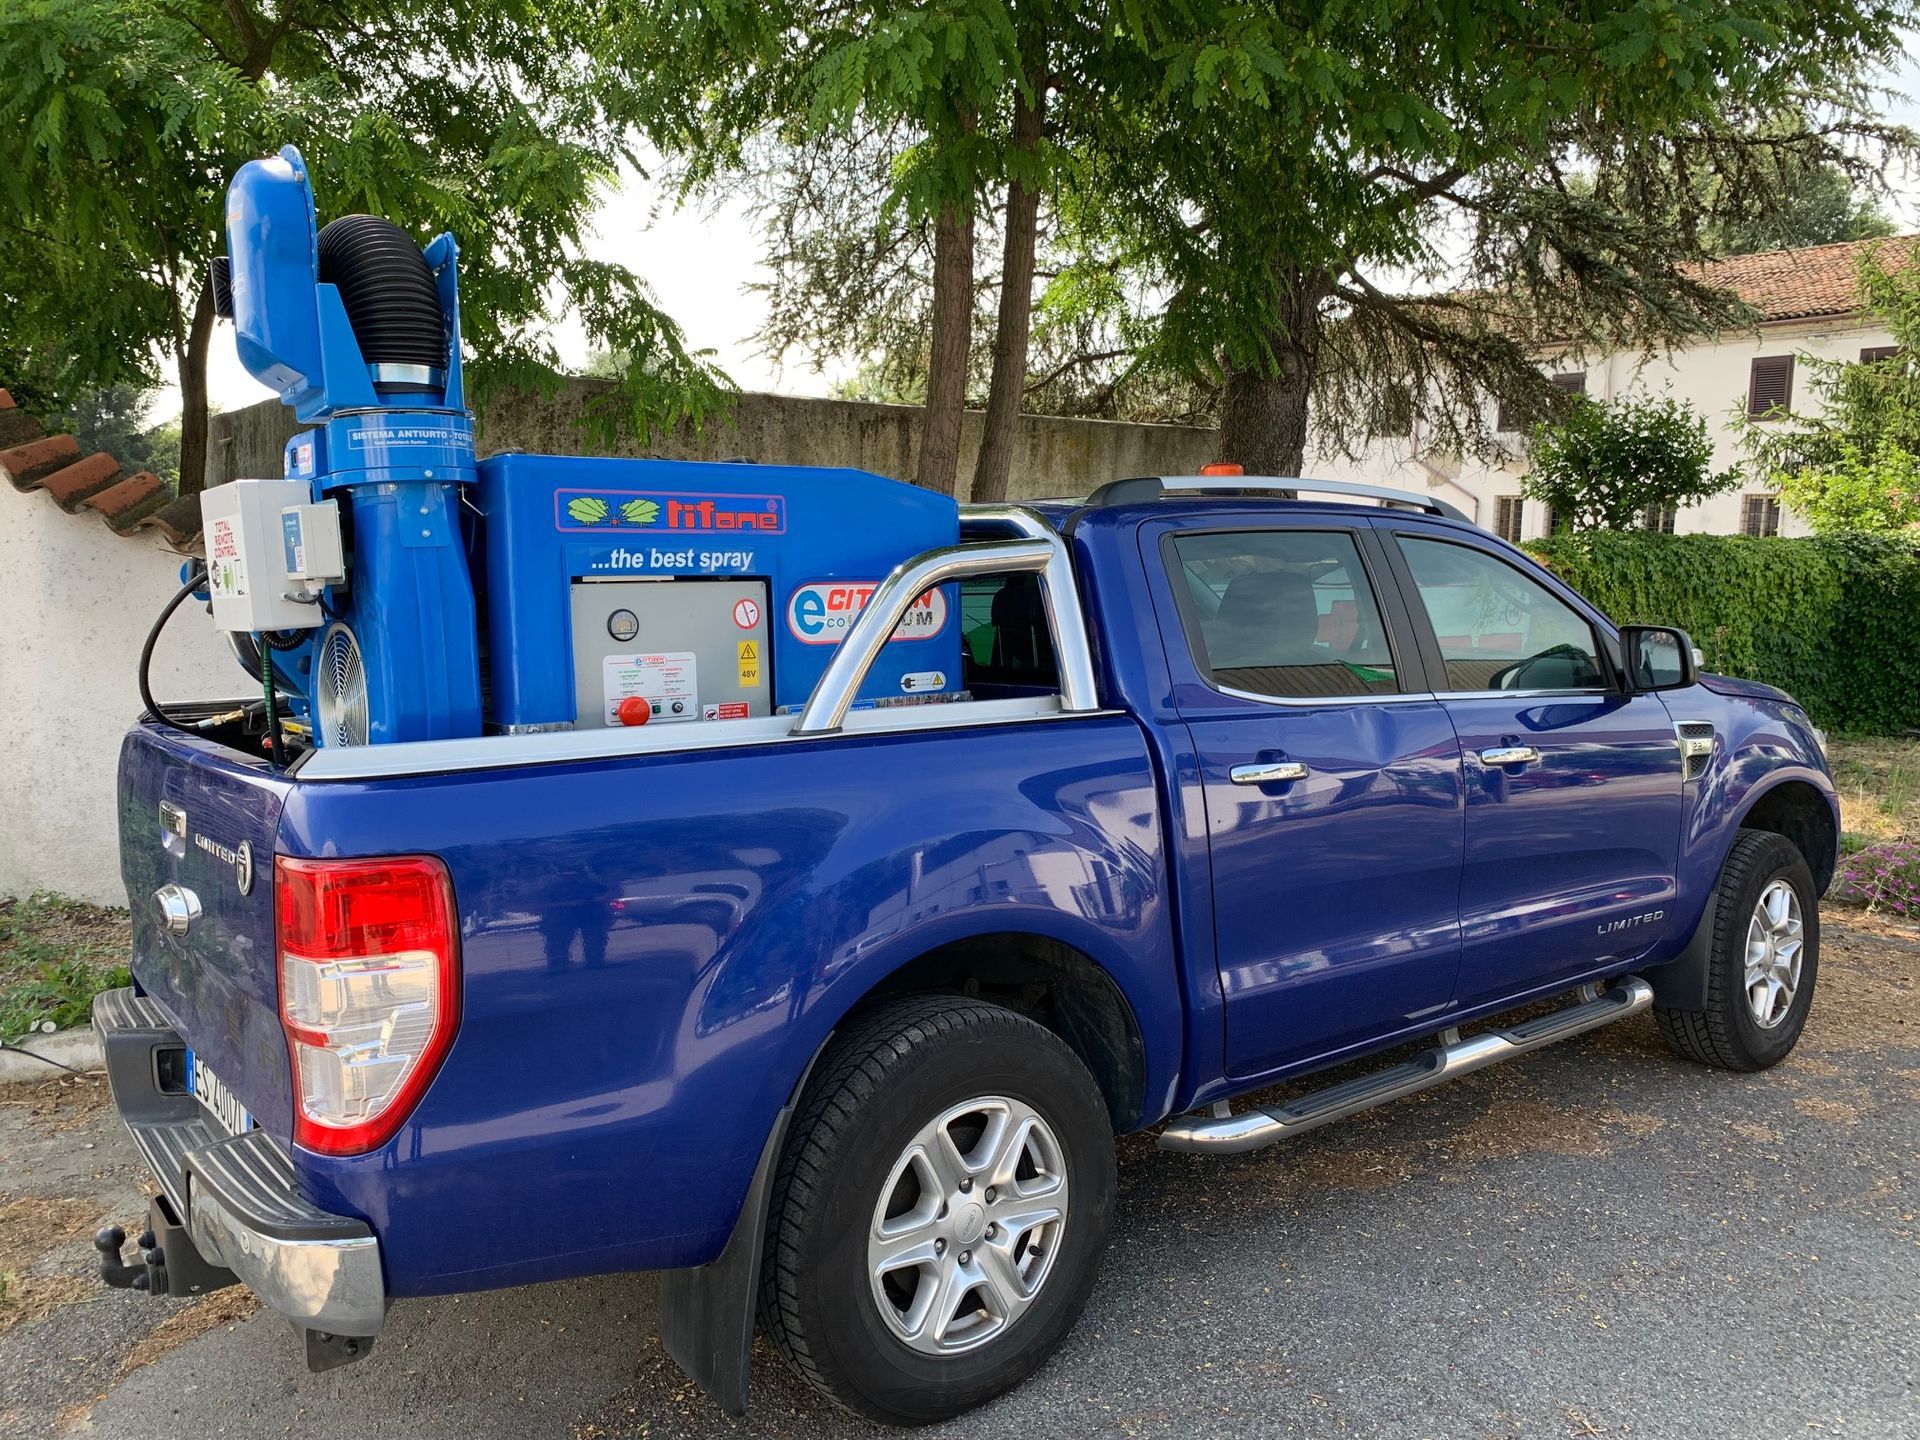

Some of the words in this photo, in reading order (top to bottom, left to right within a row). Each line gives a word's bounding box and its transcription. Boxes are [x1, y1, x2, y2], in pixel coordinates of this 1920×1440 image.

[352, 431, 395, 441] SISTEMA
[397, 430, 448, 439] ANTIURTO
[667, 499, 778, 530] tifone
[215, 520, 230, 533] TOTAL
[215, 532, 234, 546] REMOTE
[215, 545, 237, 559] CONTROL
[650, 548, 695, 568] best
[699, 551, 753, 572] spray
[741, 670, 756, 678] 48V
[195, 833, 236, 865] LIMITED
[1596, 910, 1664, 935] LIMITED
